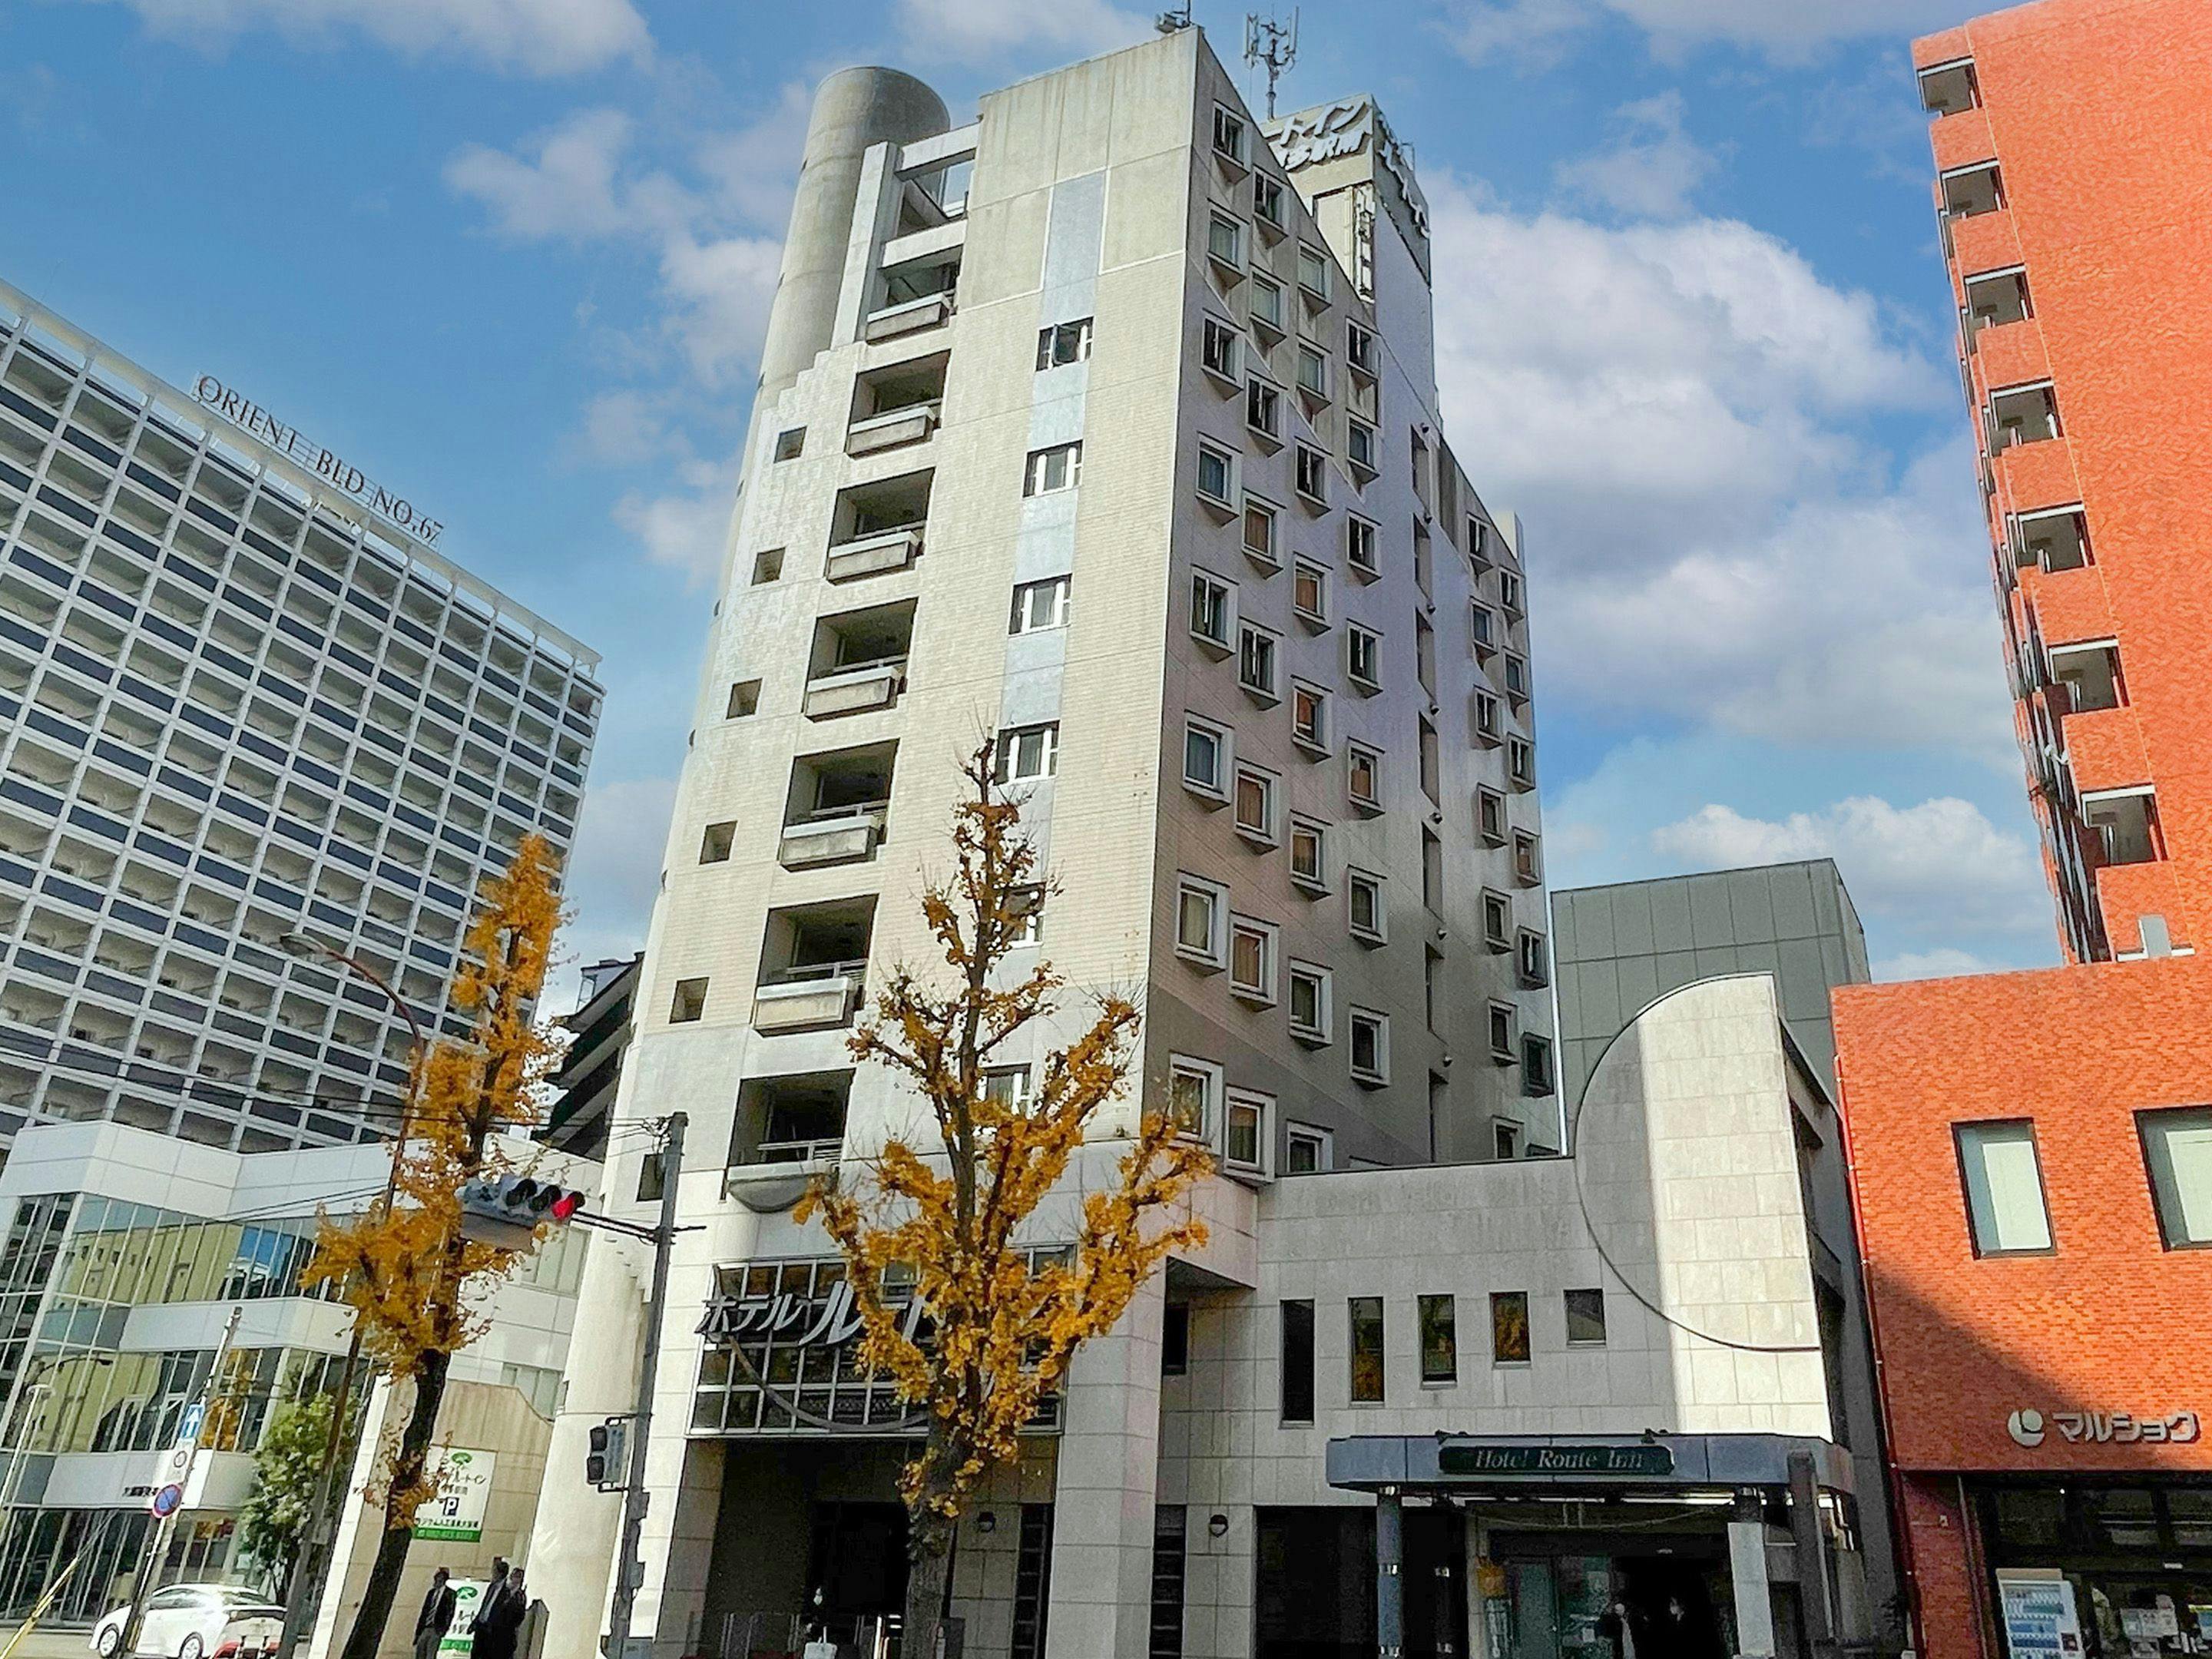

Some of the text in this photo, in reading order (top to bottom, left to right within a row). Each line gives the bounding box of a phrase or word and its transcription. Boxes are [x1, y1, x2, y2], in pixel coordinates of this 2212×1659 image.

[197, 374, 445, 542] ORIENT BLD NO.67
[2051, 1412, 2197, 1443] マルショク
[1474, 1449, 1644, 1469] Hotel Route Inn
[445, 1498, 459, 1515] P
